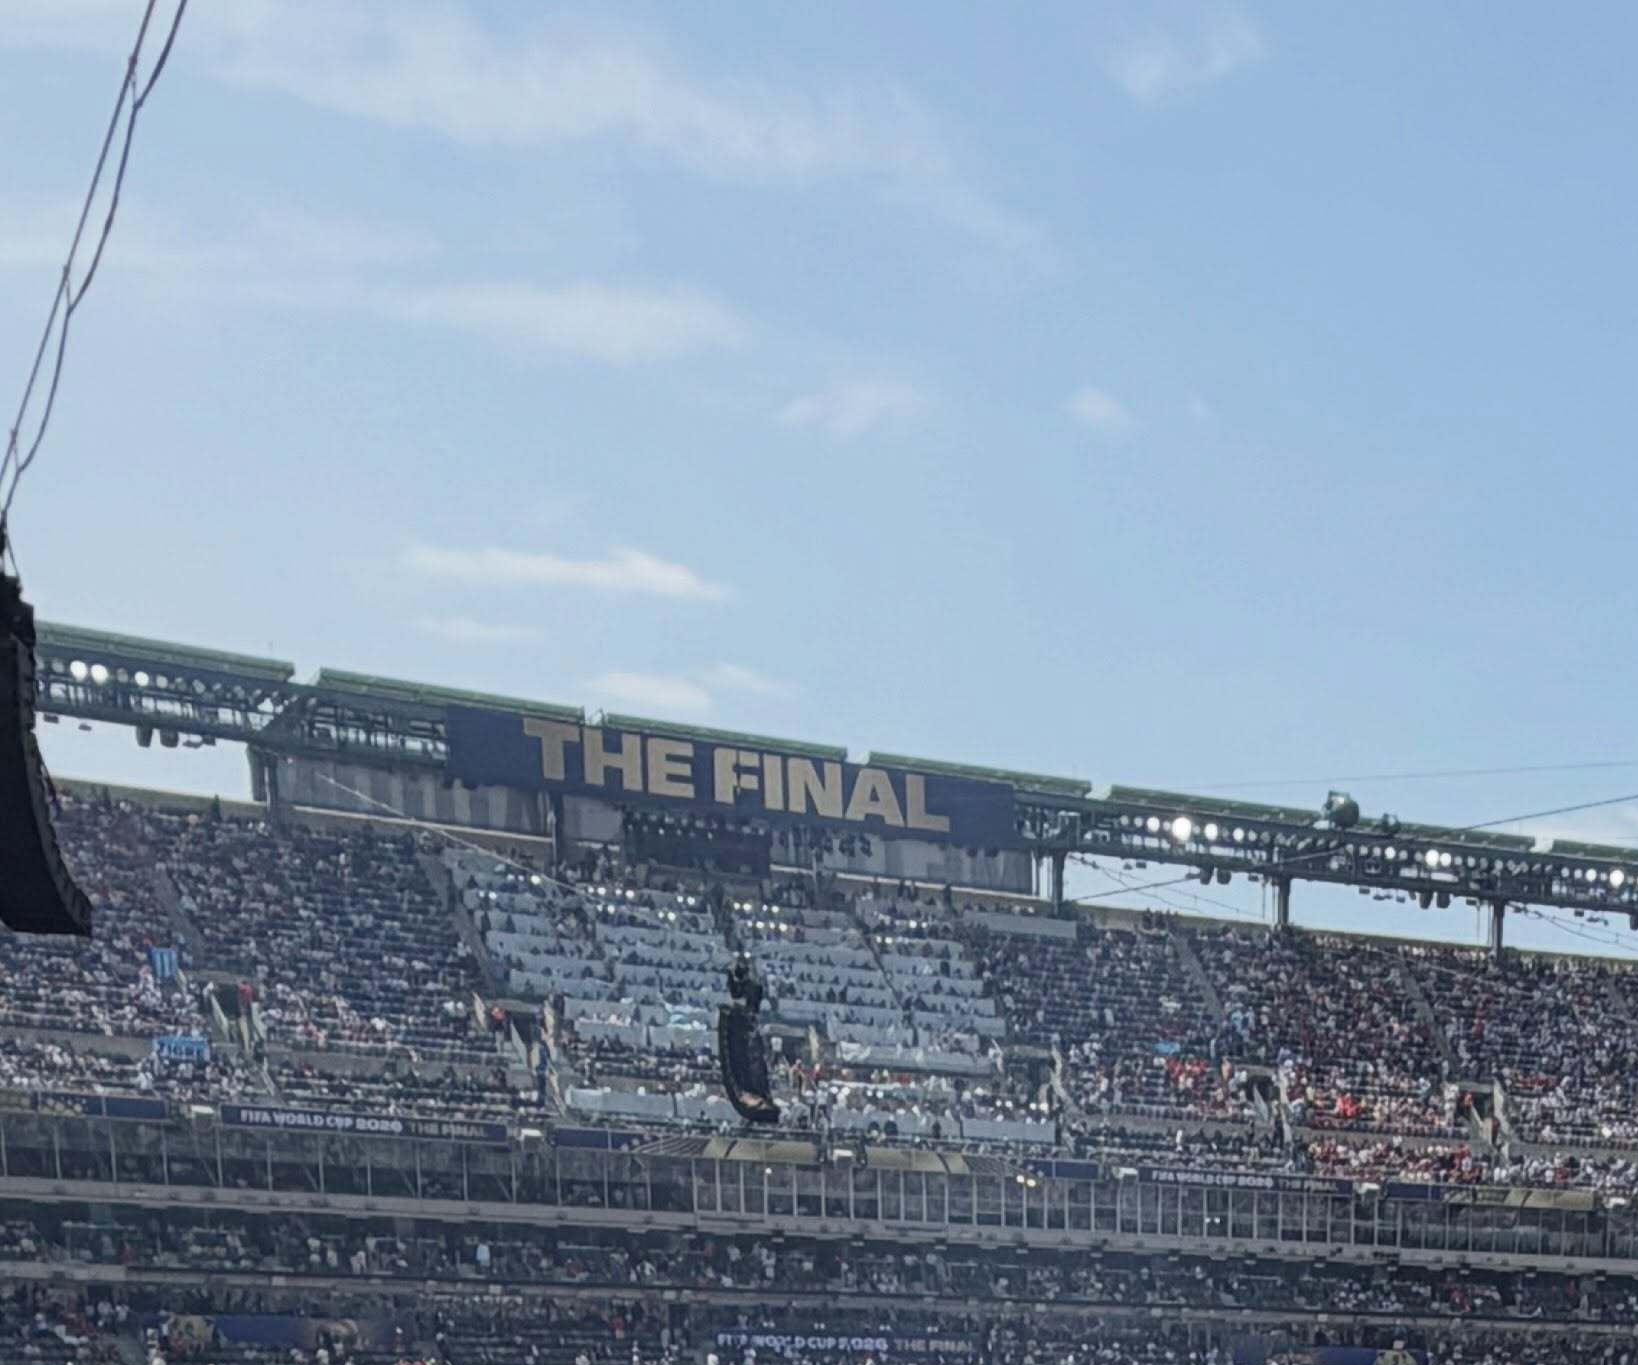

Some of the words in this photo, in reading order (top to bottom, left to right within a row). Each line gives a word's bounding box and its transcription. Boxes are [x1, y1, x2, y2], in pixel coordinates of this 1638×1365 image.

[522, 716, 696, 799] THE
[712, 747, 950, 833] FINAL
[240, 1109, 271, 1125] FIFA
[272, 1111, 324, 1128] WORLD
[325, 1116, 353, 1130] CUP
